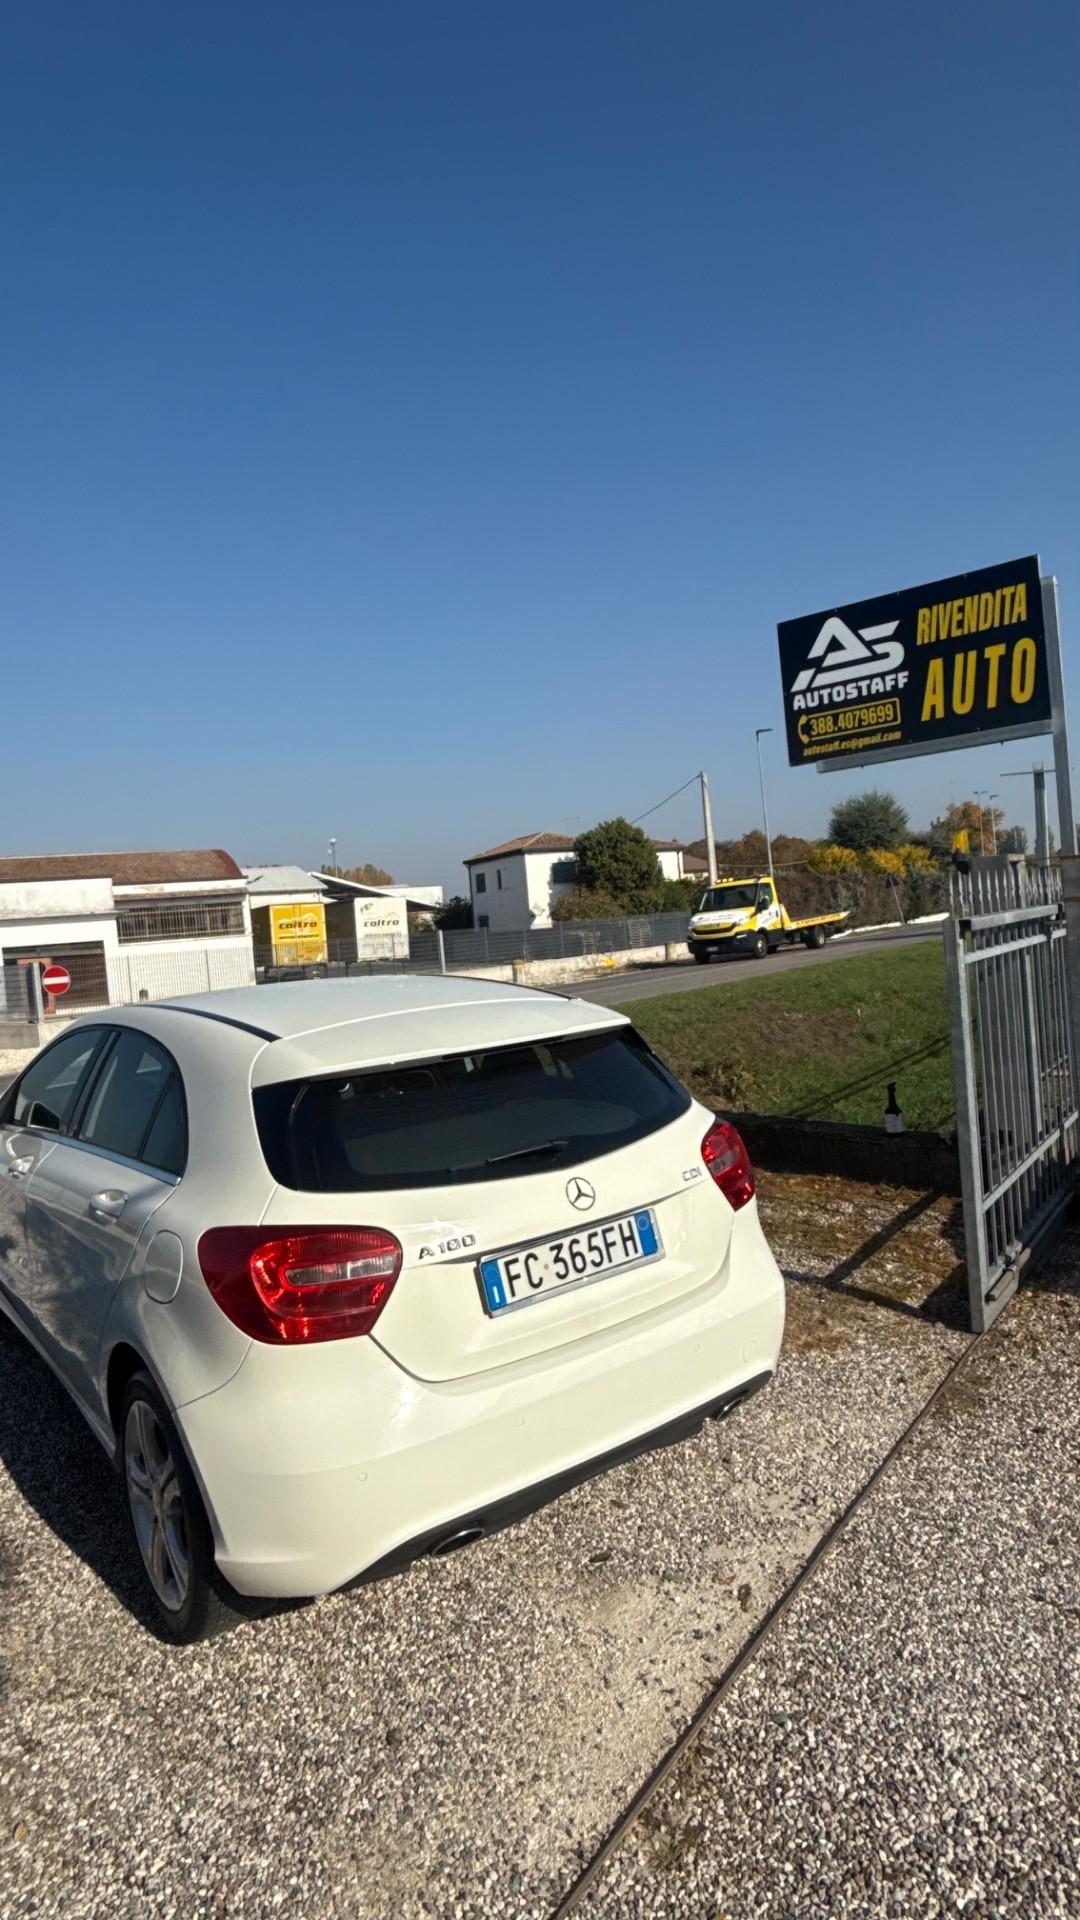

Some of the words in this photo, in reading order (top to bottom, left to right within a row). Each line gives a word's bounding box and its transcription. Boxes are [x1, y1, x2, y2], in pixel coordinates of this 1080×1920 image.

[916, 582, 1028, 646] RIVENDITA
[793, 671, 909, 711] AUTOSTAFF
[921, 637, 1037, 722] AUTO
[810, 704, 894, 736] 388.4079699
[682, 1166, 702, 1181] CDI
